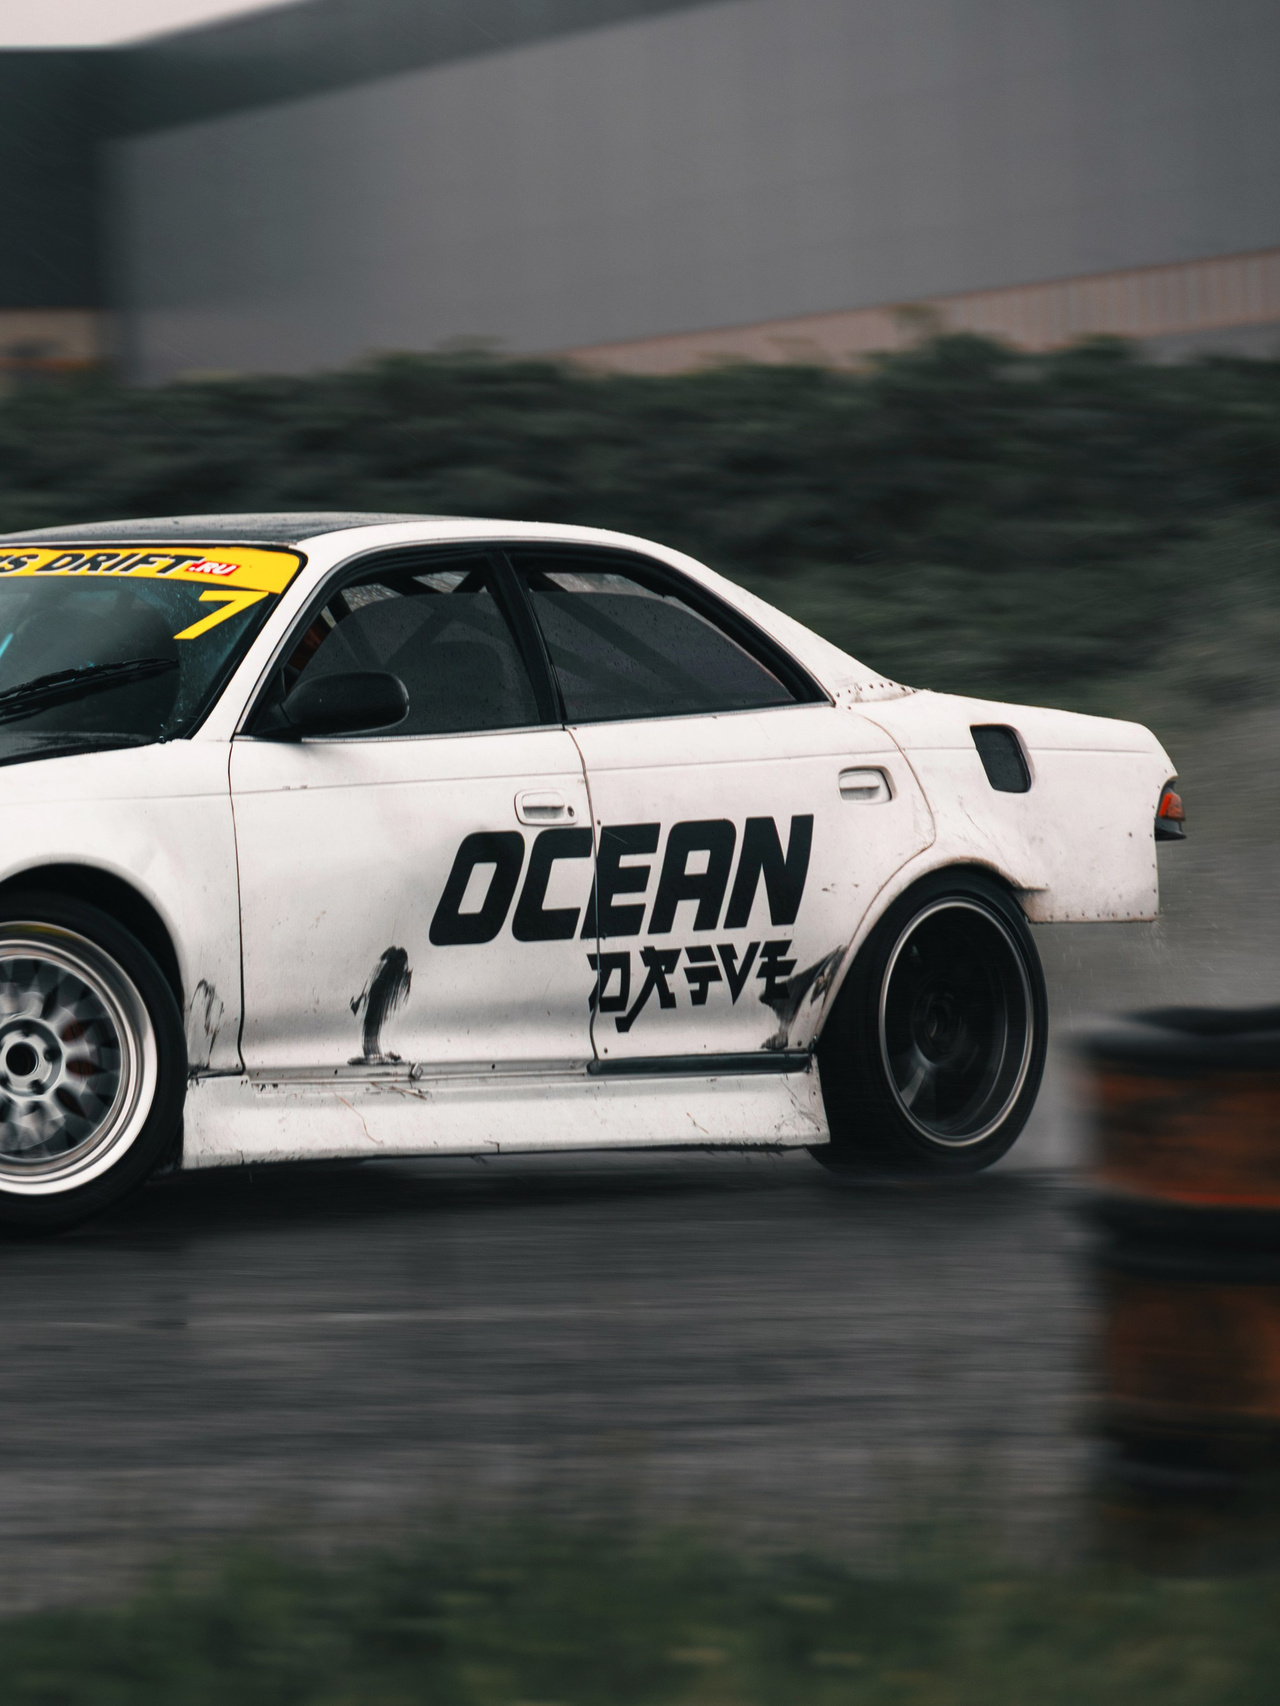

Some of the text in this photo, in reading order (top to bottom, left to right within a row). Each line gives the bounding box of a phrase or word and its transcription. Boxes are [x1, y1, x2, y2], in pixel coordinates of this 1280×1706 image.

[173, 590, 269, 639] 7
[429, 814, 814, 946] OCEAN
[587, 939, 798, 1033] DRIVE
